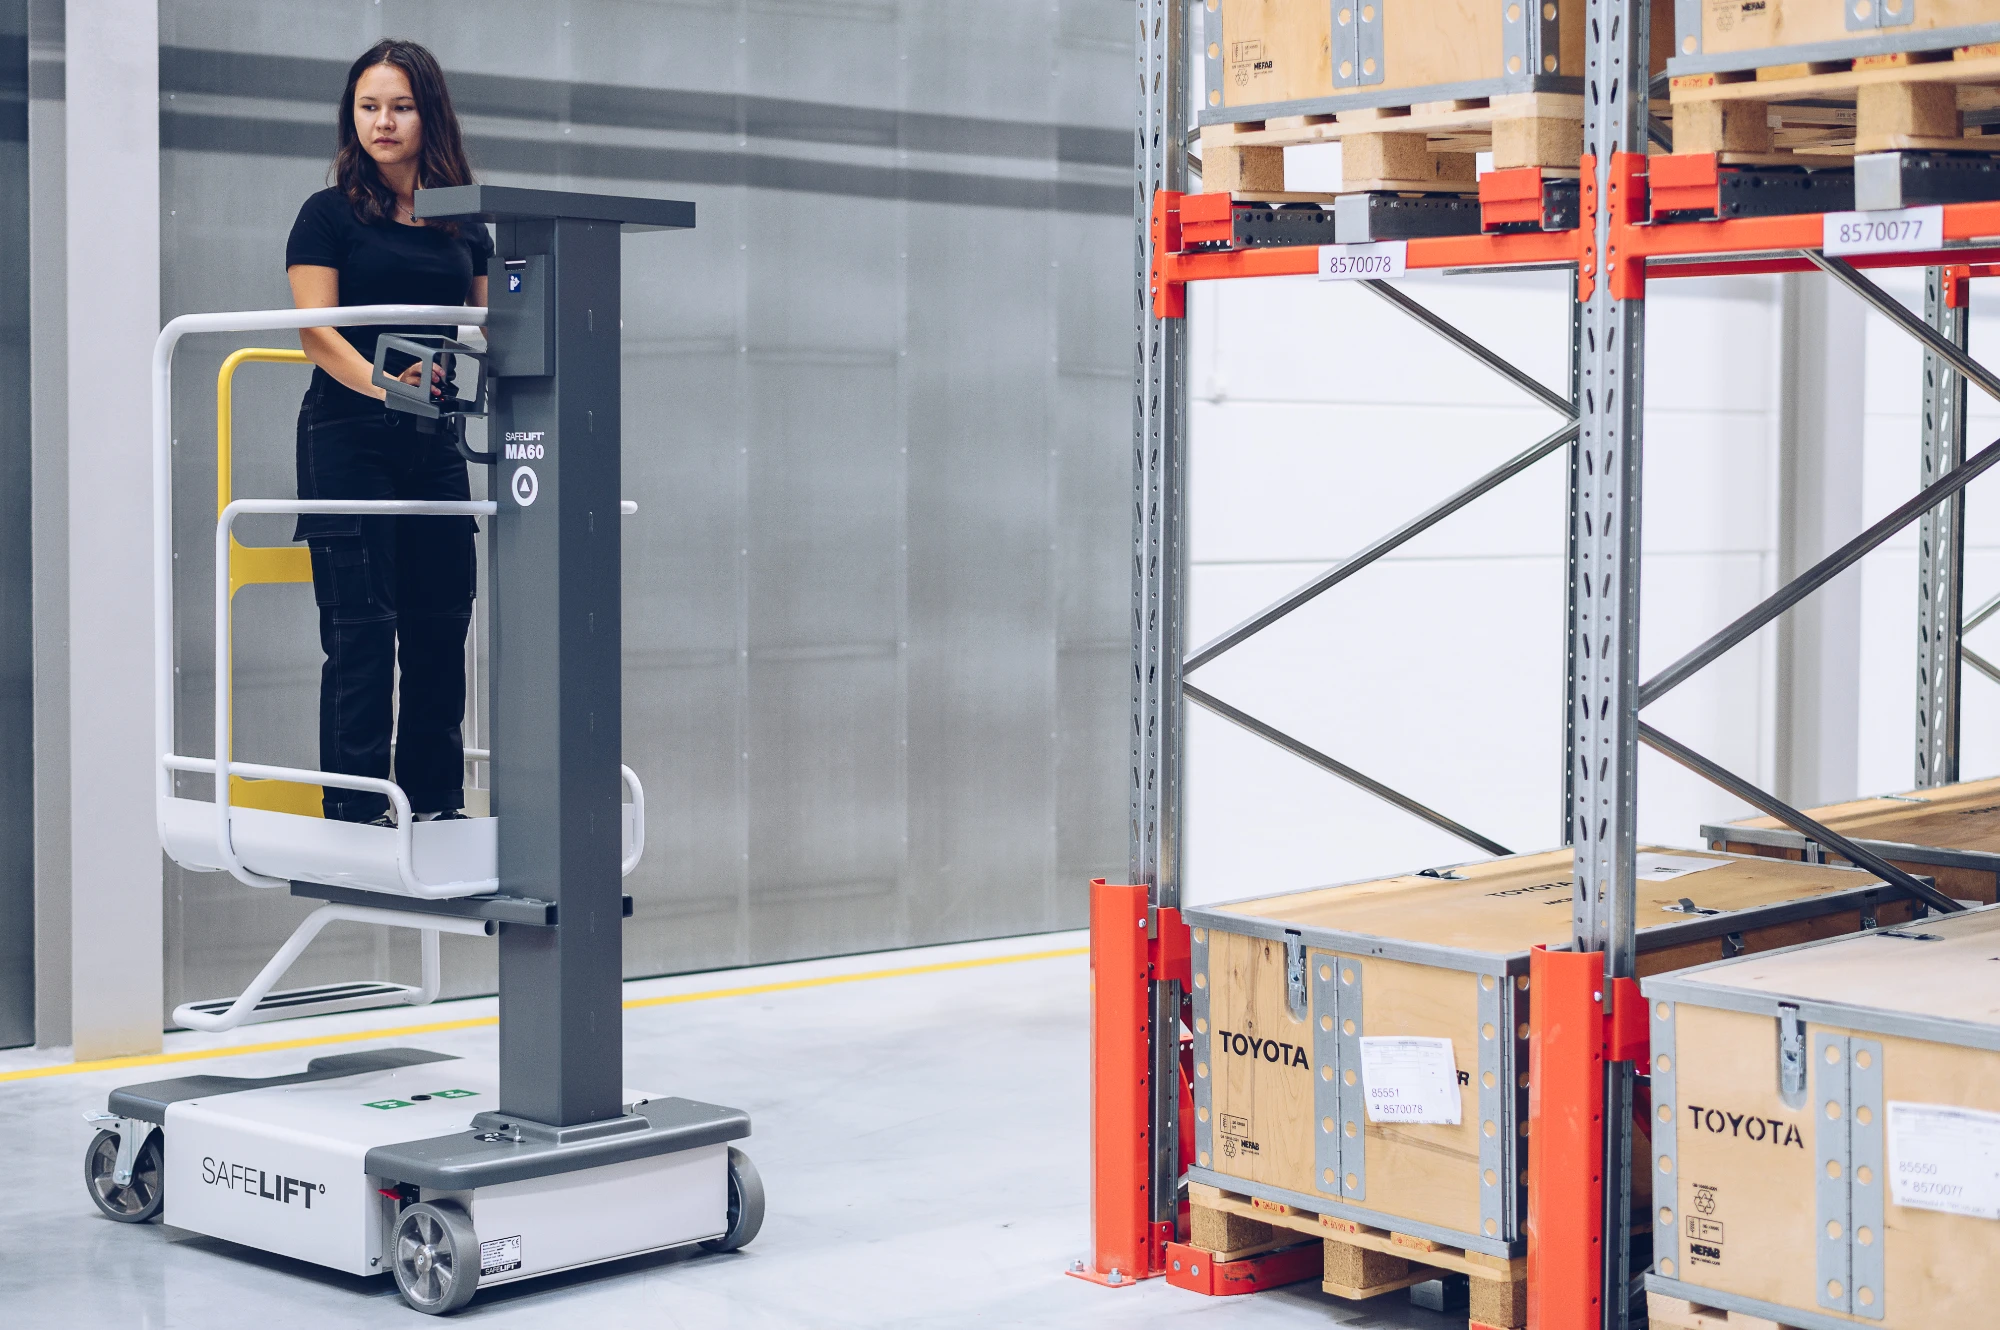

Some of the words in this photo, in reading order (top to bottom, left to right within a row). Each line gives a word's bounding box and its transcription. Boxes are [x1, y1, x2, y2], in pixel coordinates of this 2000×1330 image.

[1253, 61, 1273, 70] NEFAB
[1840, 220, 1922, 243] 8570077
[1330, 256, 1391, 273] 8570078
[505, 431, 542, 441] SAFELIFT
[505, 443, 545, 460] MA60
[1218, 1029, 1310, 1070] TOYOTA
[1371, 1087, 1400, 1098] 85551
[1383, 1104, 1423, 1114] 8570078
[1688, 1104, 1804, 1149] TOYOTA
[1241, 1139, 1260, 1151] NEFAB
[1899, 1160, 1937, 1175] 85550
[202, 1156, 318, 1209] SAFELIFT
[1913, 1181, 1963, 1197] 8570077
[1690, 1243, 1721, 1259] NEFAB
